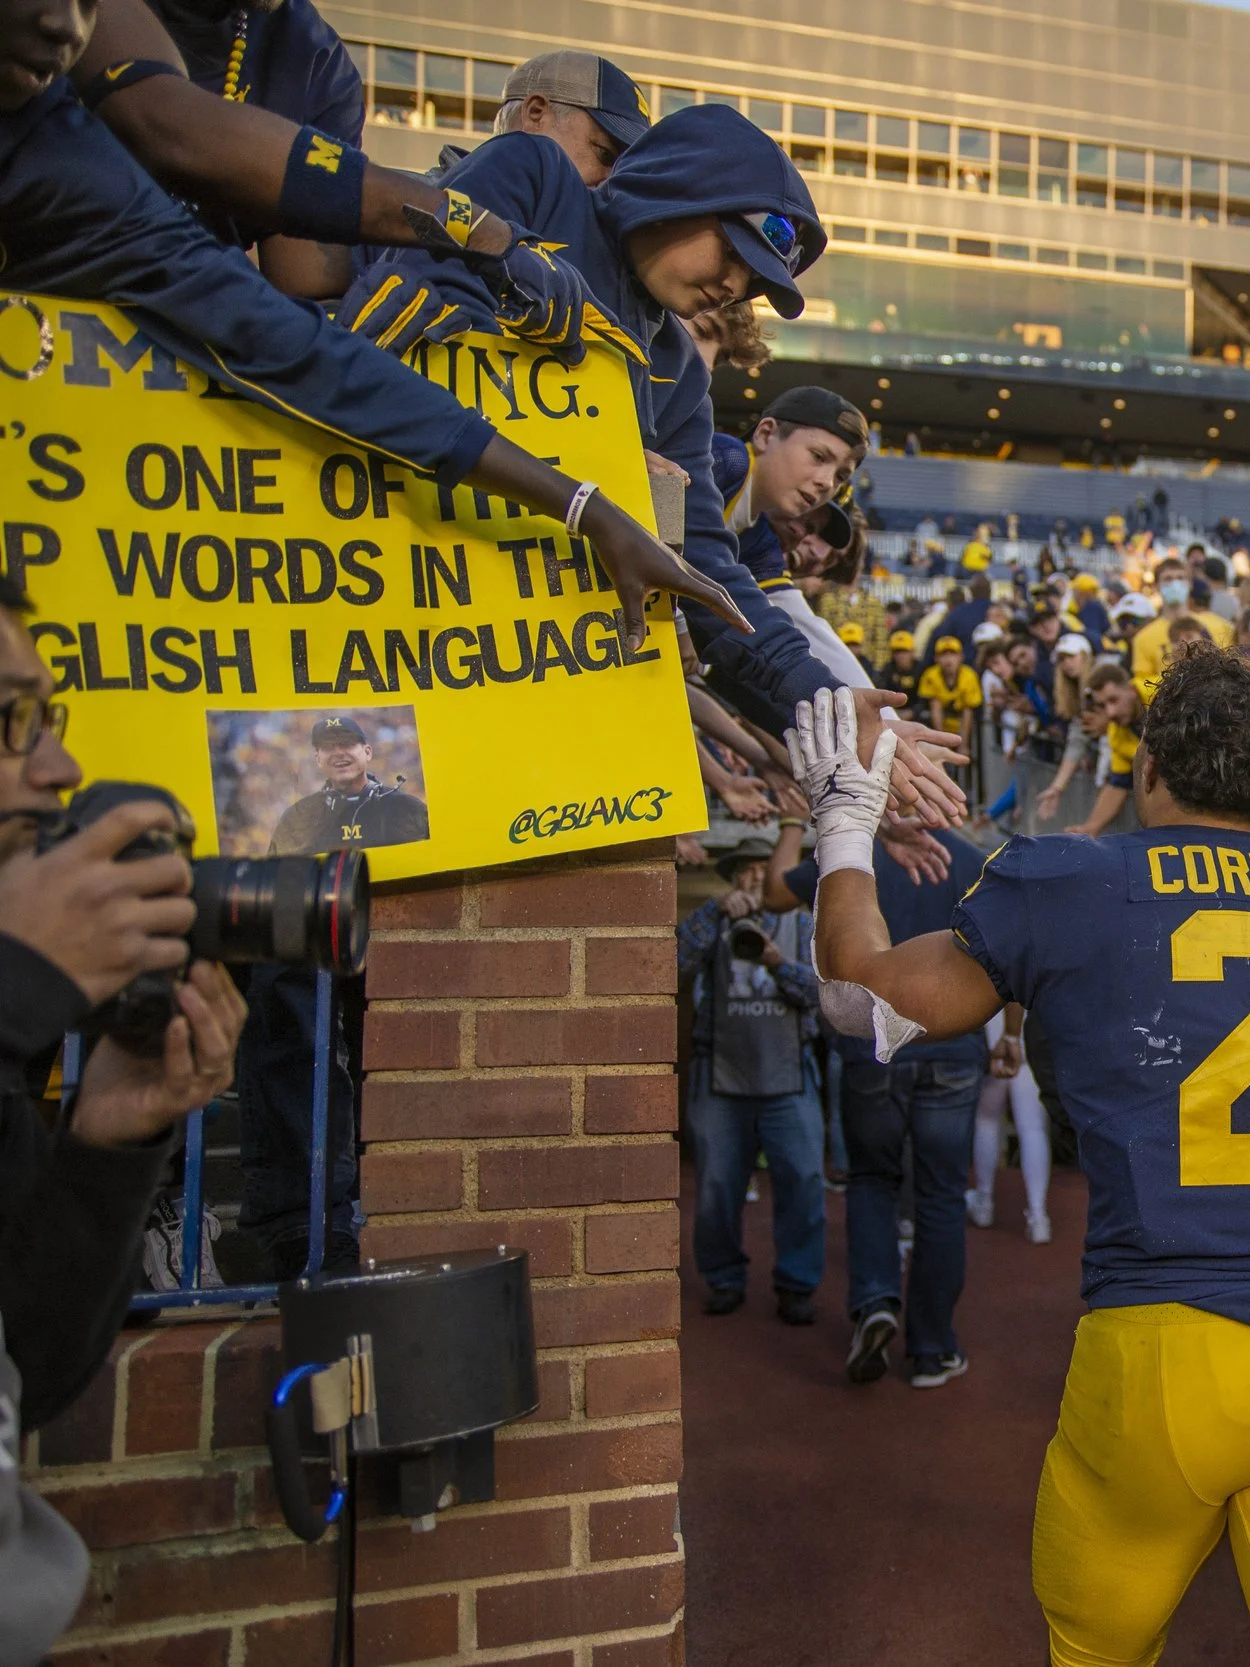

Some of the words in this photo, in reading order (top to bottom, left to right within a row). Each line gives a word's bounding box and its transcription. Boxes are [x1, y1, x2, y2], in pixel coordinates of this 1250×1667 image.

[305, 135, 343, 174] M
[449, 199, 471, 225] M
[0, 421, 86, 502] 'S
[125, 443, 284, 515] ONE
[319, 452, 405, 520] OF
[0, 521, 62, 592] P
[96, 527, 385, 607] WORDS
[411, 543, 473, 609] IN
[497, 536, 613, 599] TH
[290, 607, 661, 694] LANGUAGE
[341, 824, 362, 840] M
[508, 786, 673, 844] @GBLANC3
[727, 1000, 789, 1017] PHOTO
